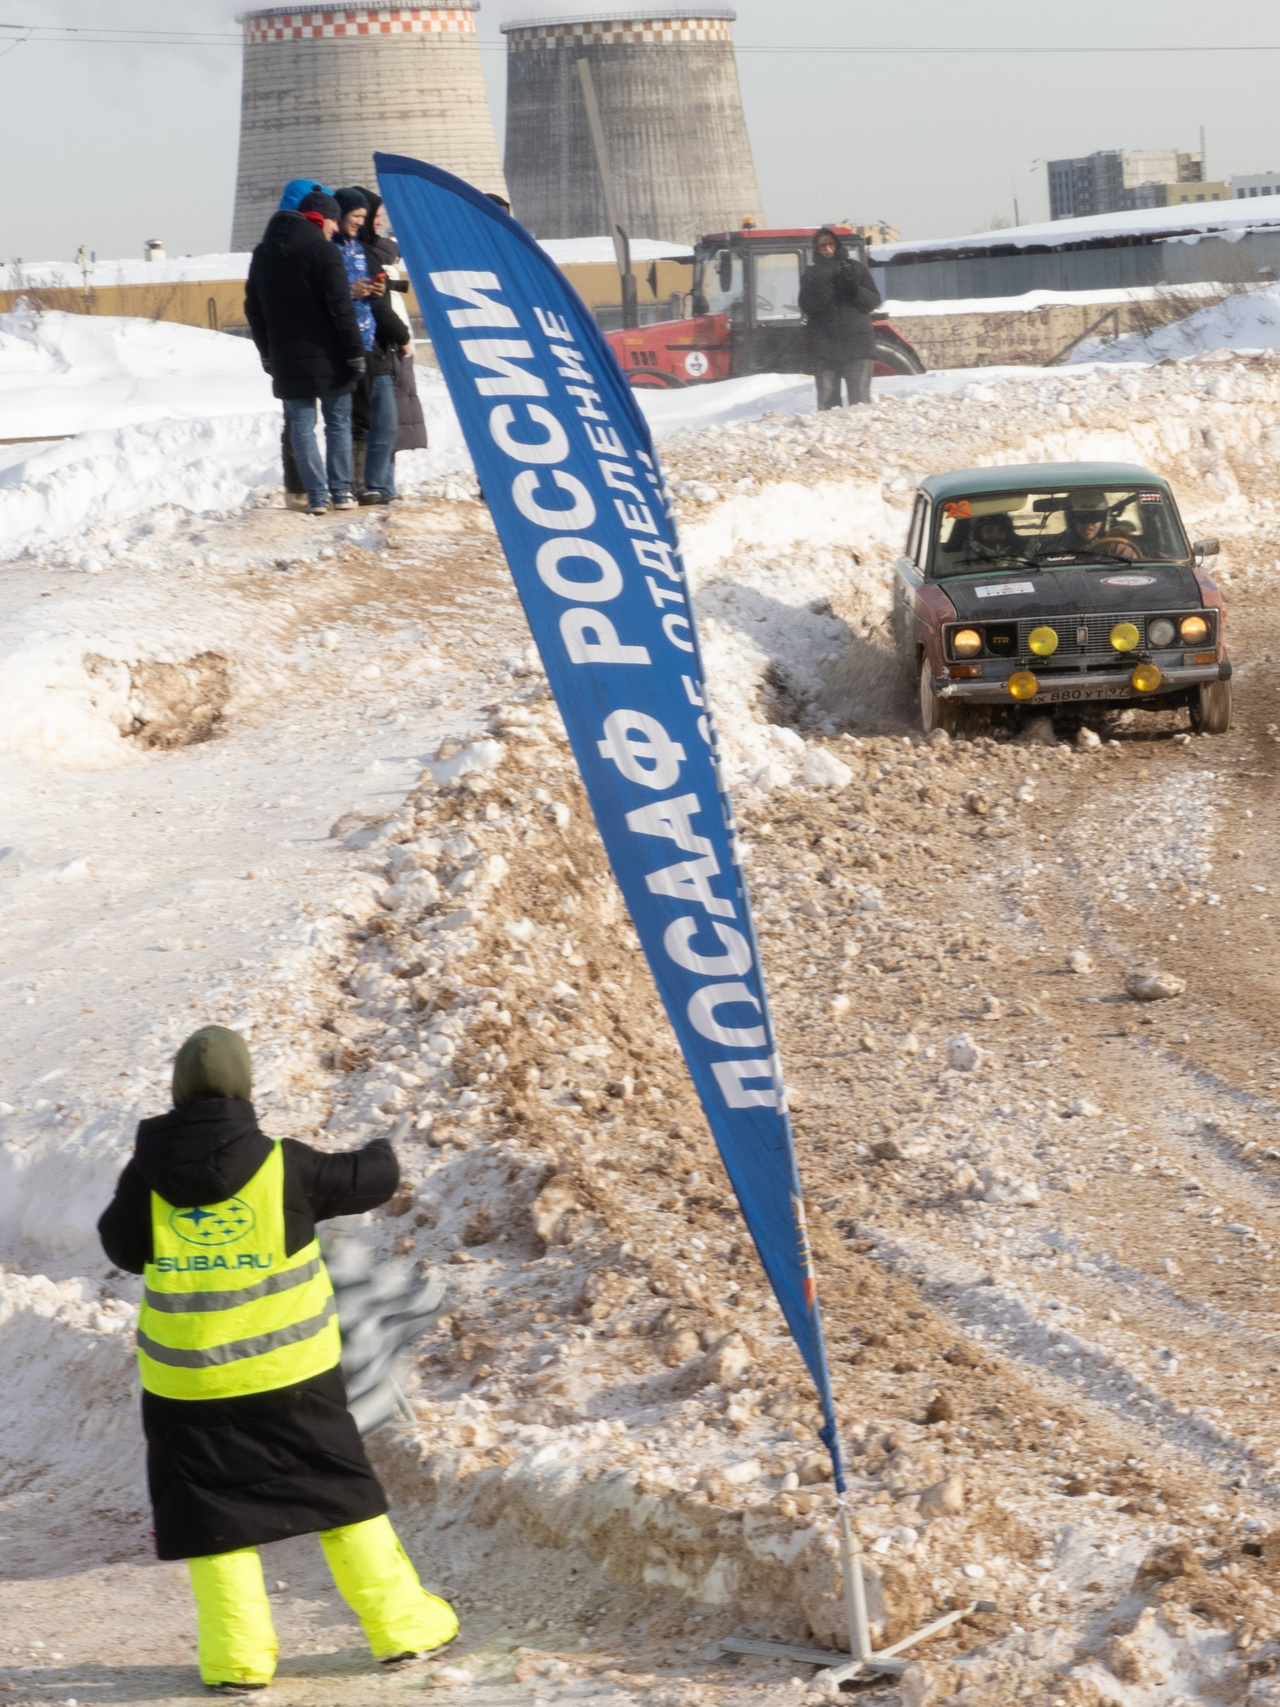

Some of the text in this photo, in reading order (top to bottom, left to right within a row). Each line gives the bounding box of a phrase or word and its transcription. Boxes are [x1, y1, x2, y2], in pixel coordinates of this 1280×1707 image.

[429, 270, 652, 665] РОССИИ
[533, 306, 695, 653] ОТДЕЛЕНИЕ
[156, 1253, 273, 1272] SUBA.RU
